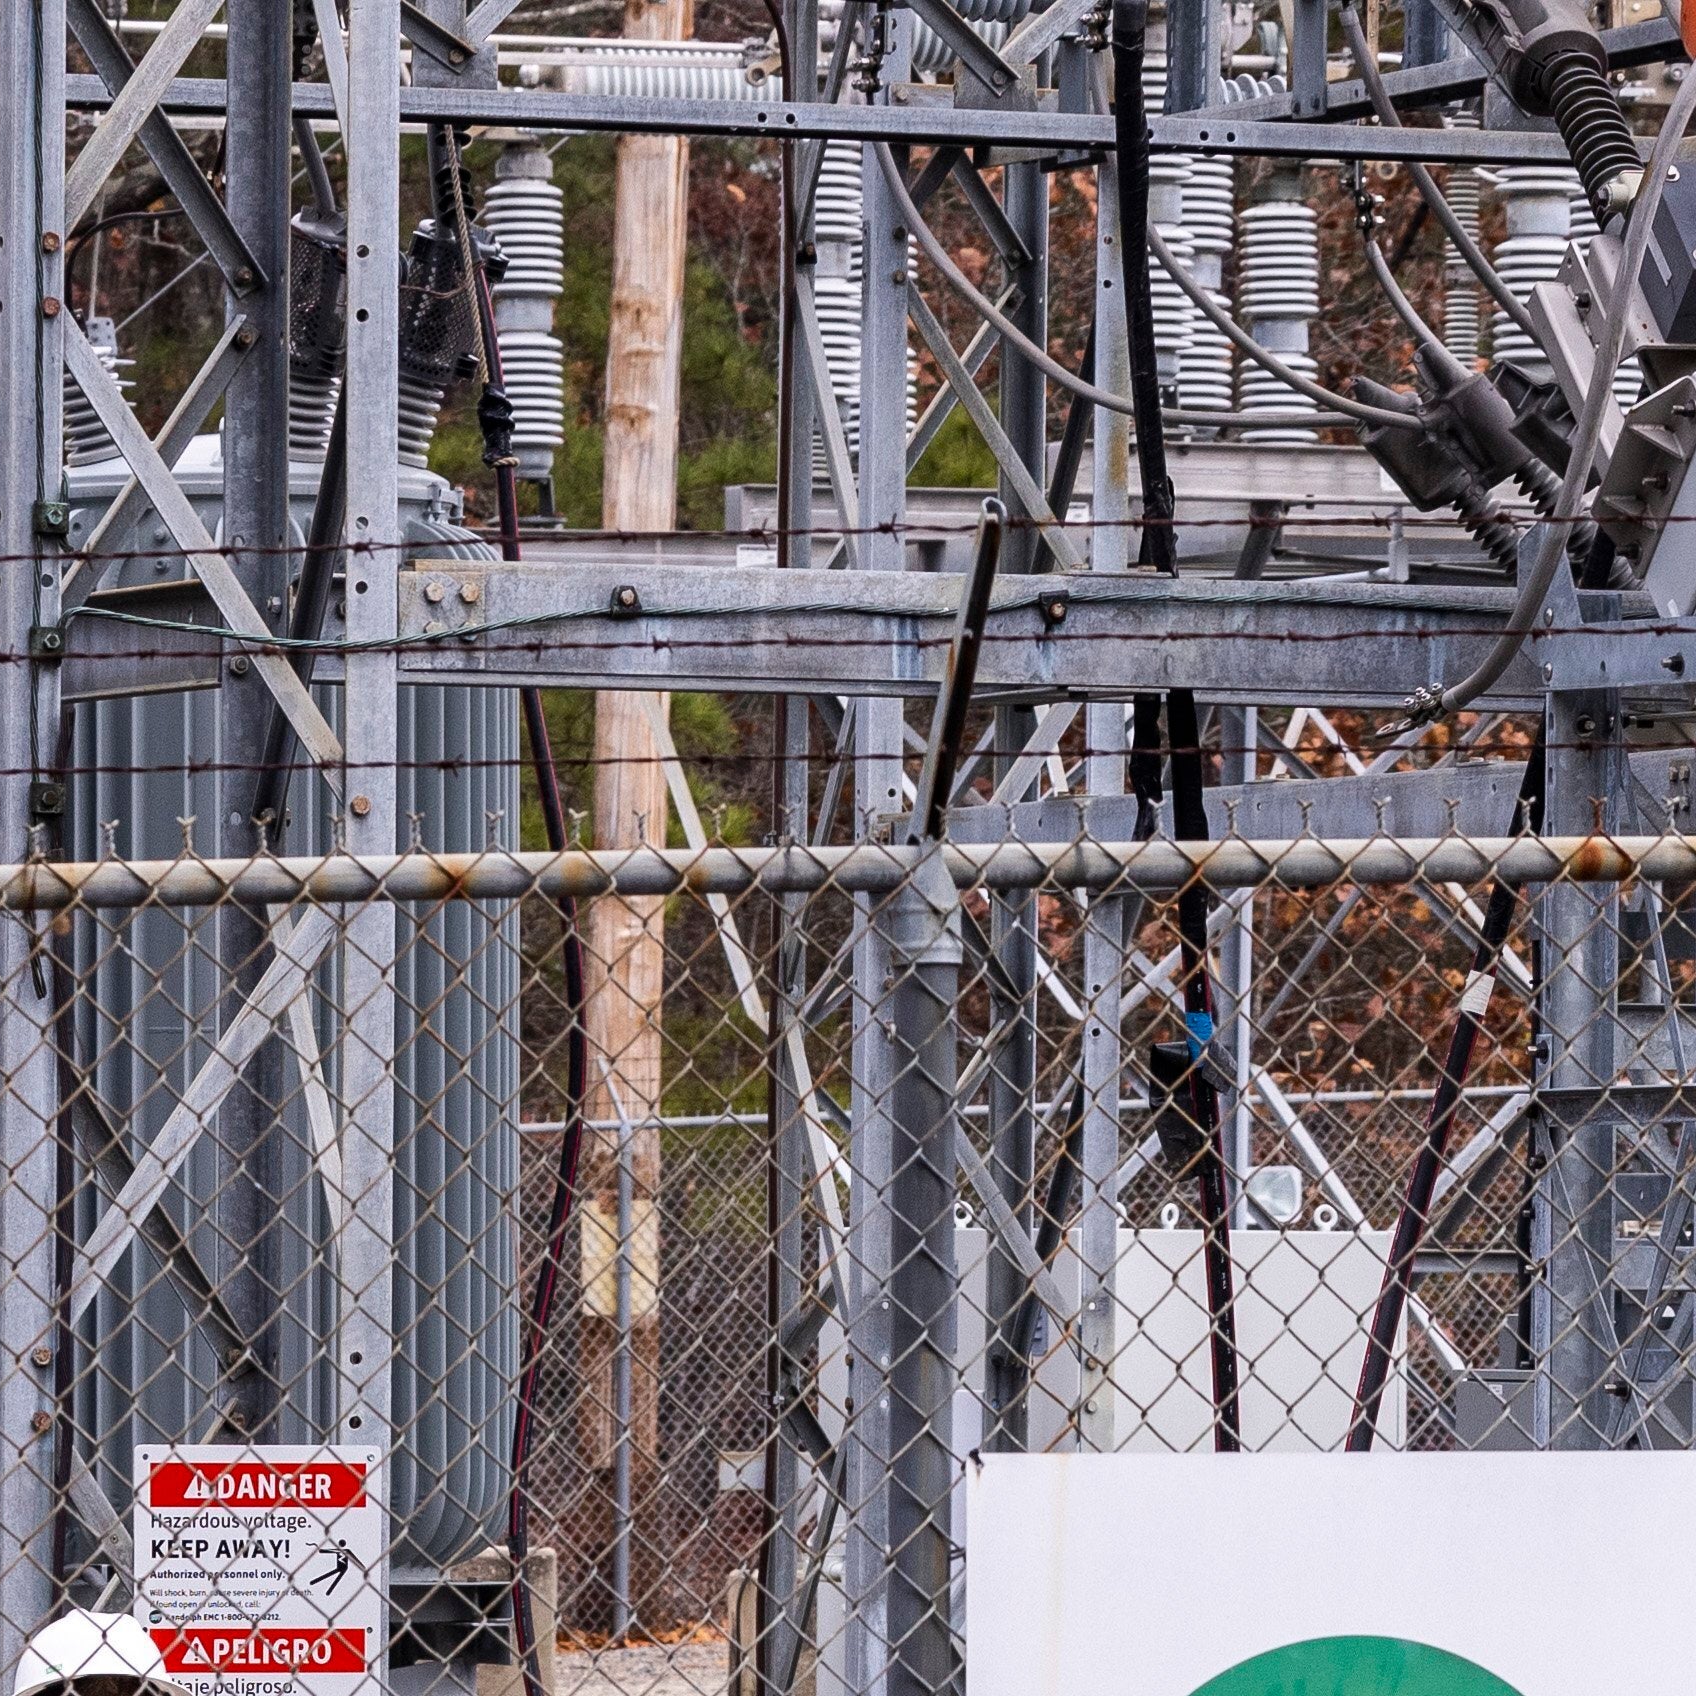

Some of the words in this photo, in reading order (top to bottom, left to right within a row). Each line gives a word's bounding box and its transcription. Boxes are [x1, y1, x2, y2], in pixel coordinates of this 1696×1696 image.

[218, 1474, 332, 1499] DANGER
[151, 1512, 240, 1529] Hazardous
[244, 1512, 312, 1533] voltage.
[151, 1539, 209, 1558] KEEP
[216, 1539, 290, 1558] AWAY!
[150, 1569, 205, 1579] Authorized
[260, 1569, 285, 1581] only.
[204, 1613, 219, 1621] EMC
[213, 1638, 332, 1665] PELIGRO
